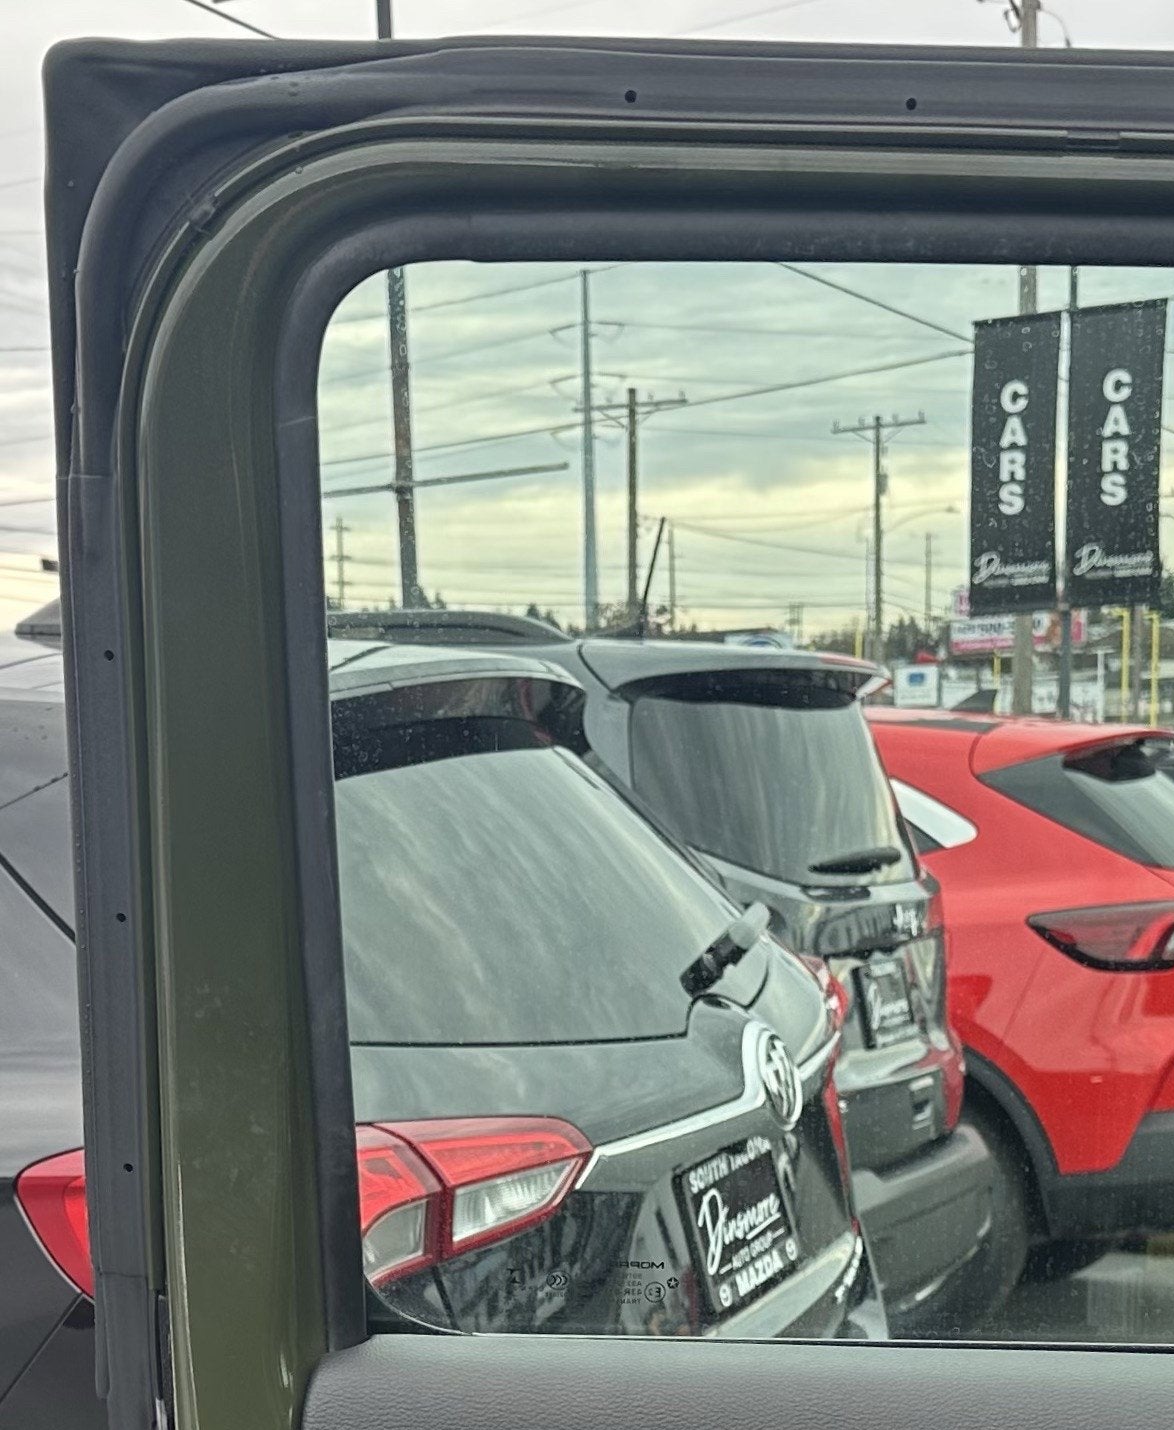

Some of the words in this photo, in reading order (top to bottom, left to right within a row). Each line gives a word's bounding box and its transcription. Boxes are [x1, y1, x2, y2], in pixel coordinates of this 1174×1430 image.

[998, 379, 1029, 515] CARS
[1100, 368, 1133, 506] CARS
[689, 1153, 729, 1194] SOUTH
[735, 1249, 784, 1297] MAZDA
